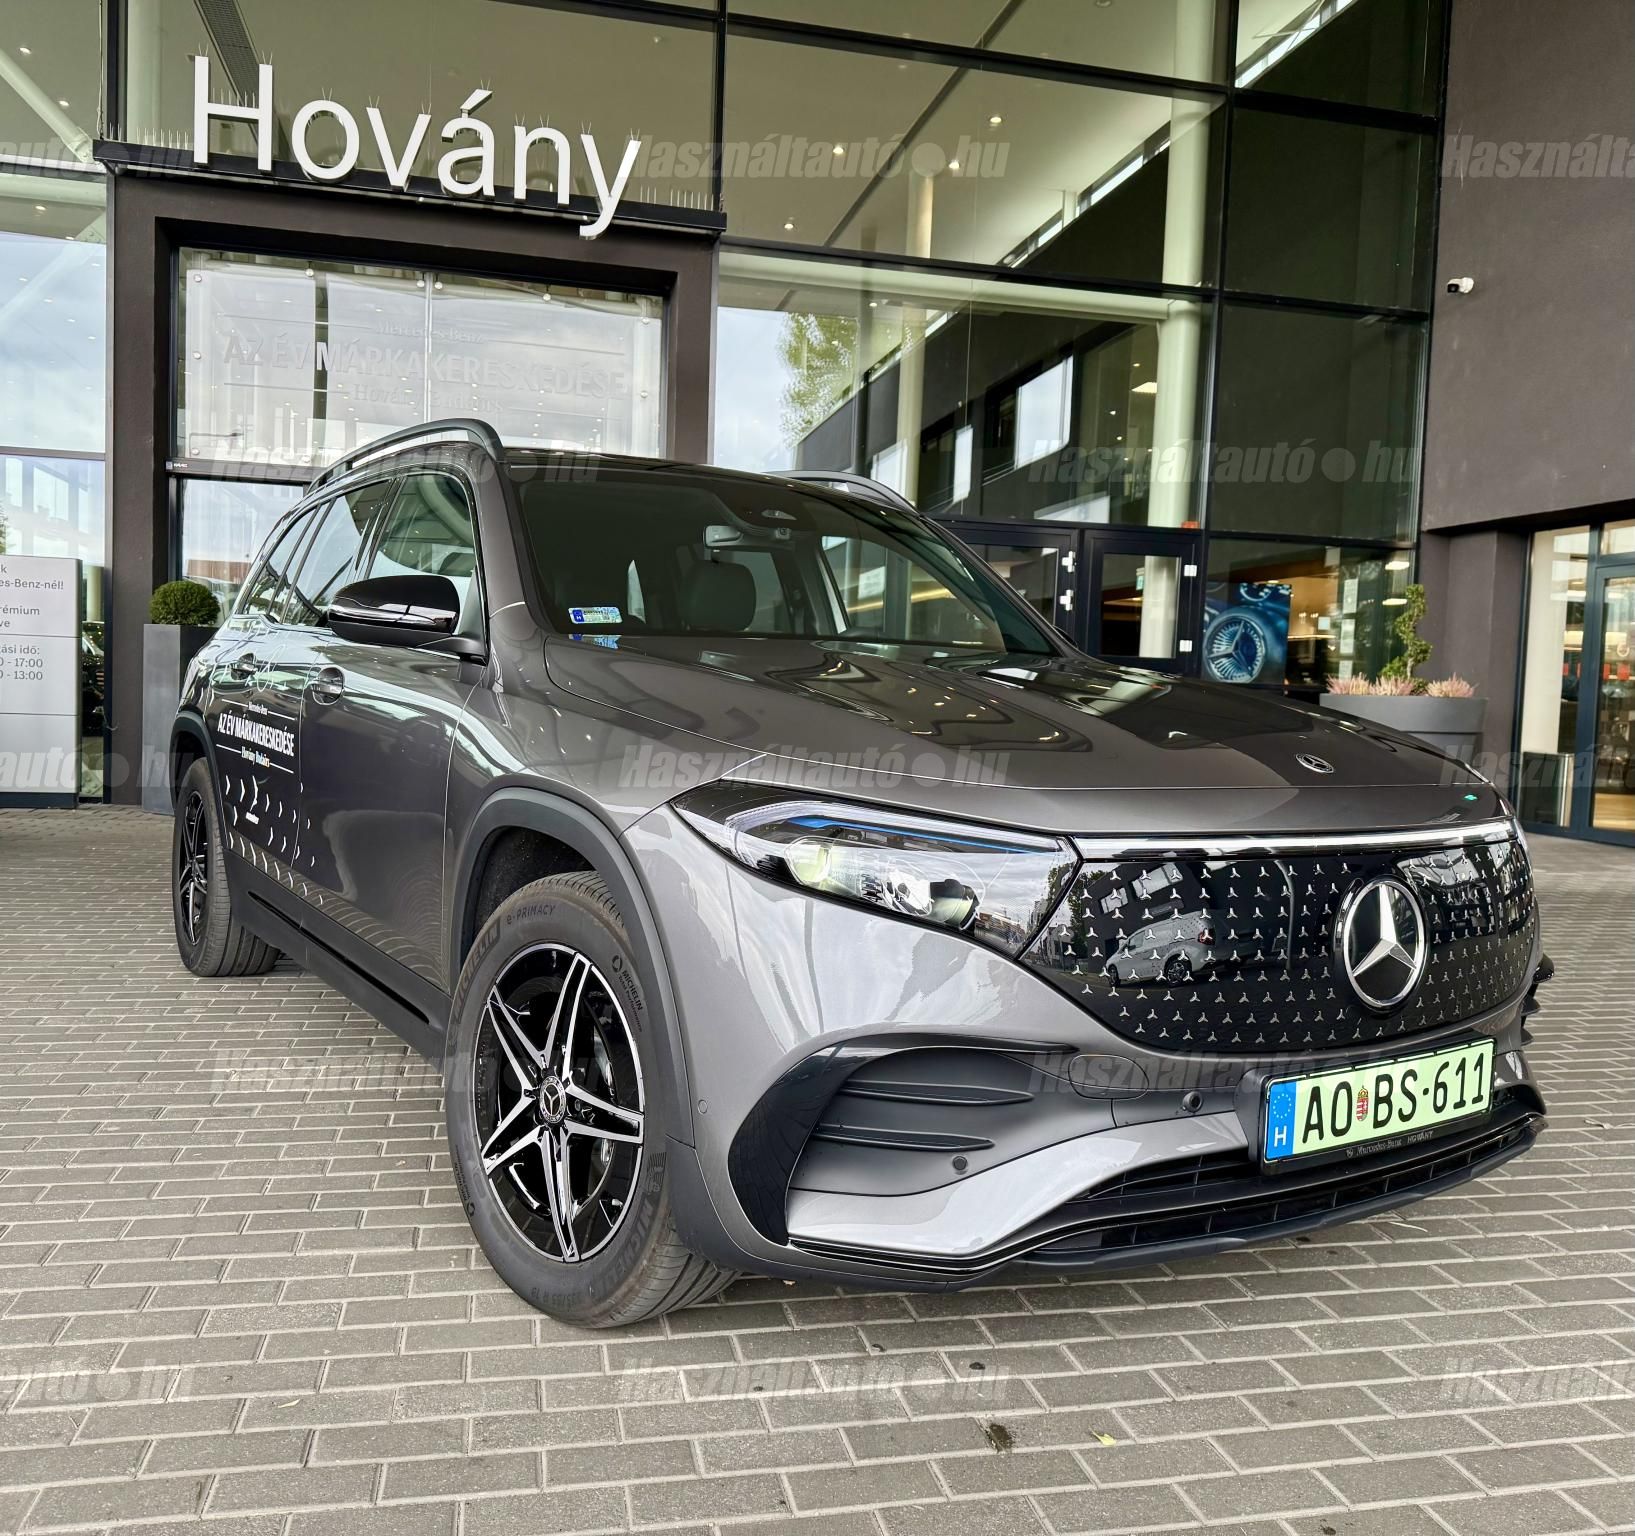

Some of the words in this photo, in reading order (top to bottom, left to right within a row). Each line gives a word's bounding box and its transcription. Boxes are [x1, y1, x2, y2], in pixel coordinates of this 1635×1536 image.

[192, 55, 641, 239] Hovány
[223, 334, 264, 367] AZ
[0, 644, 17, 654] ási
[15, 657, 43, 668] 17:00
[14, 670, 43, 680] 13:00
[621, 970, 644, 1011] MICHELIN
[1273, 1125, 1287, 1148] H
[1302, 1081, 1352, 1144] AO
